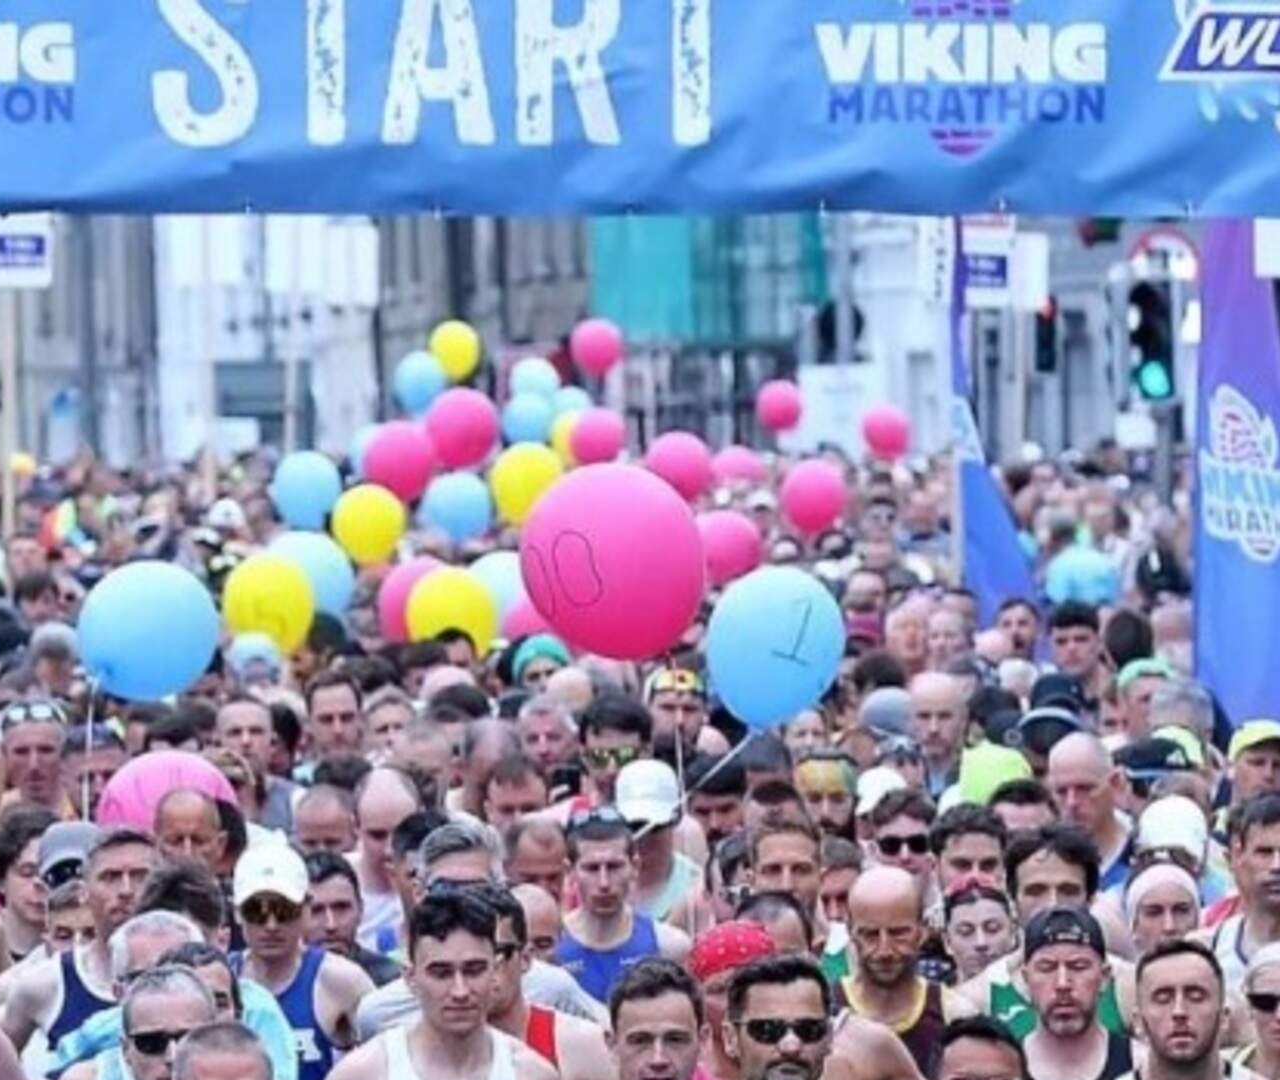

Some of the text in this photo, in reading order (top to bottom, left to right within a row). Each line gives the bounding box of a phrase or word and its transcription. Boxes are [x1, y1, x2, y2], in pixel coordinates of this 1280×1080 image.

[153, 0, 711, 146] START
[815, 23, 1107, 83] VIKING
[828, 85, 1107, 124] MARATHON
